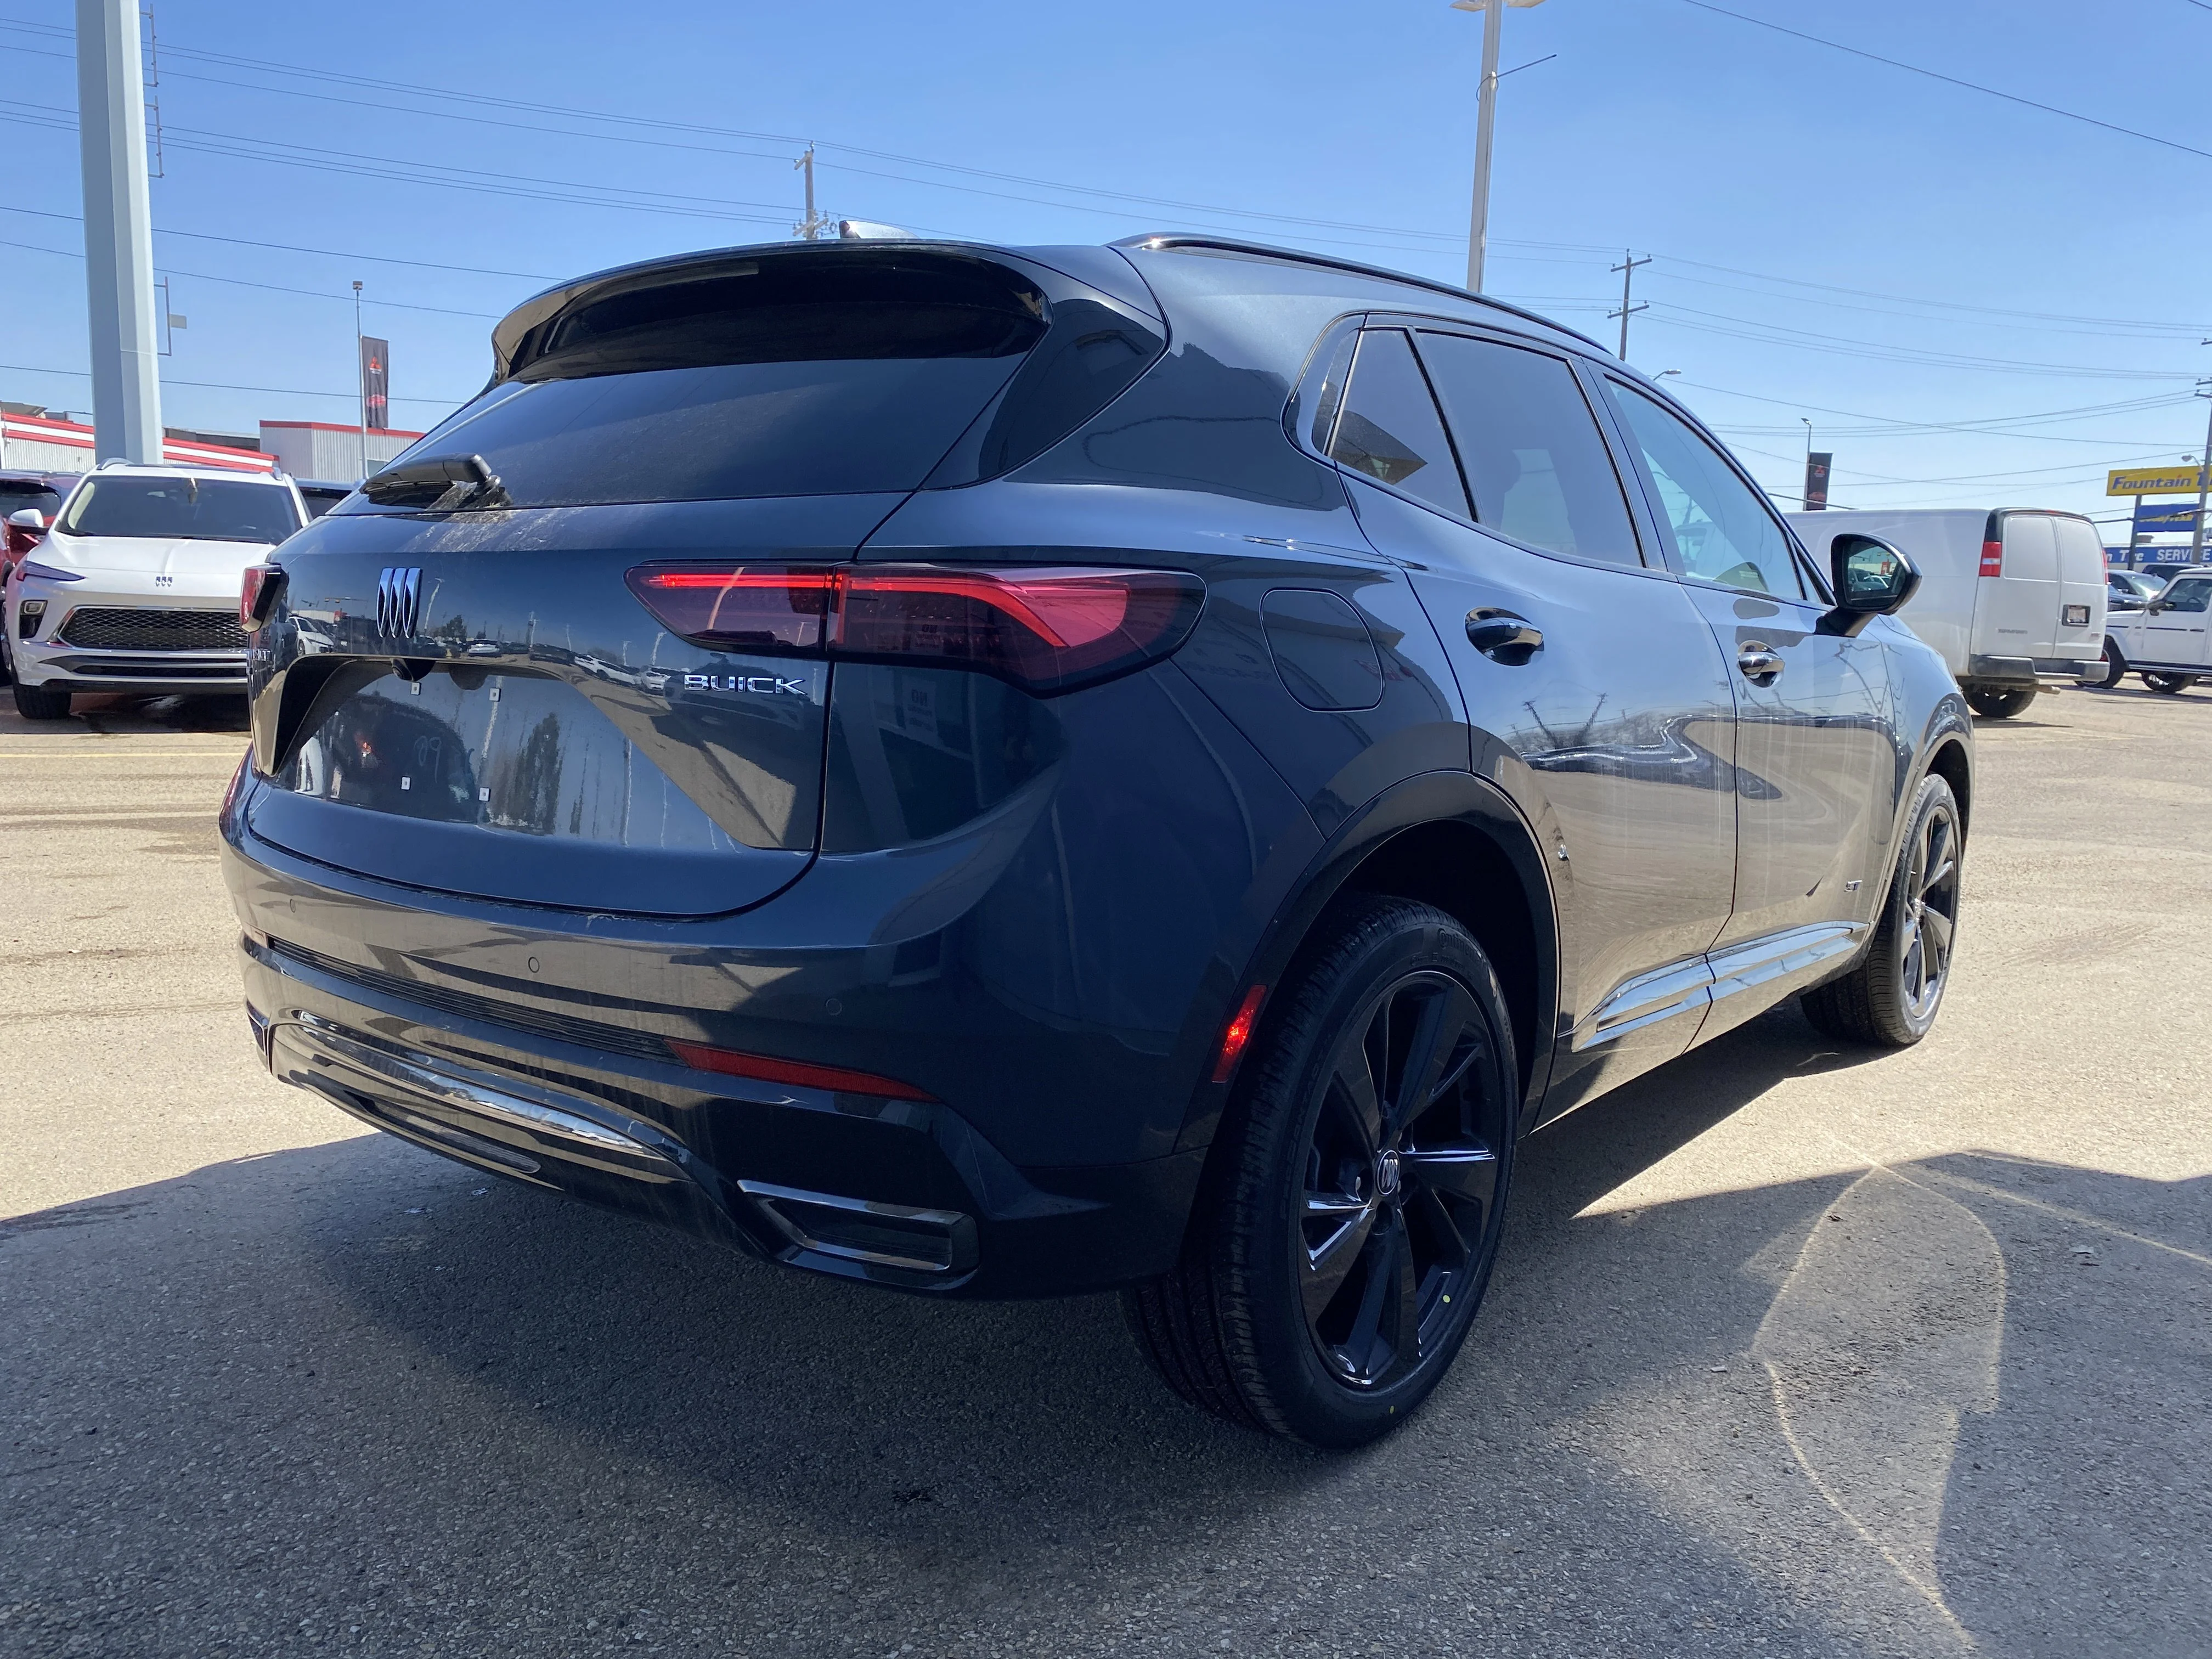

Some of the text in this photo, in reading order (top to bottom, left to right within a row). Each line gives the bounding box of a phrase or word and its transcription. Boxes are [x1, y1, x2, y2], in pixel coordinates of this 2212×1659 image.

[2112, 474, 2192, 489] Fountain
[2157, 549, 2211, 561] SERVIE
[684, 674, 807, 696] BUICK
